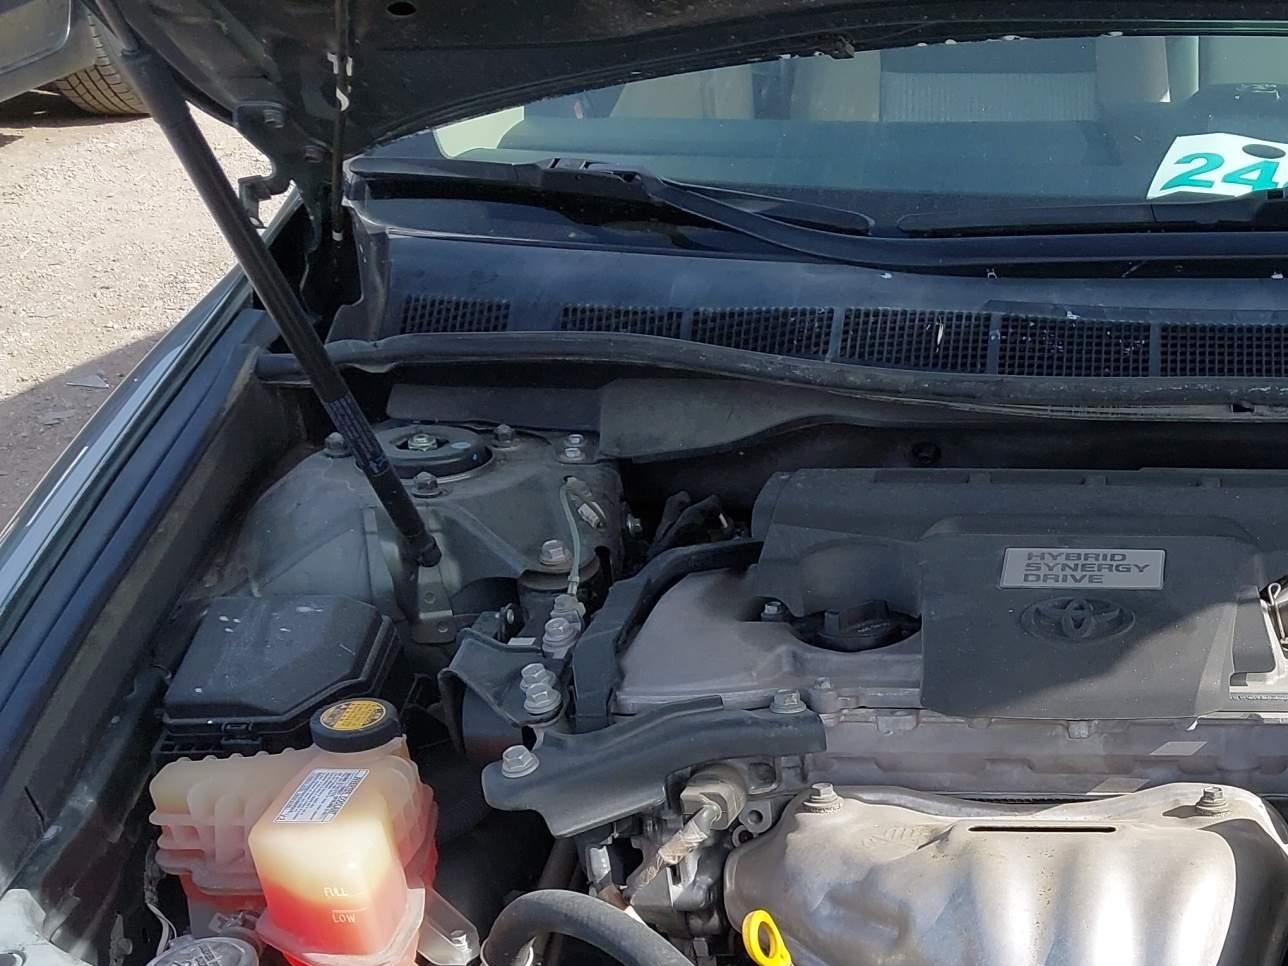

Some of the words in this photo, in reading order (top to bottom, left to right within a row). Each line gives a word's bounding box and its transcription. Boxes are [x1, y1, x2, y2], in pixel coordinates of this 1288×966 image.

[1027, 552, 1127, 562] HYBRID
[1024, 562, 1151, 573] SYNERGY
[1023, 573, 1104, 584] DRIVE
[323, 887, 349, 897] FULL
[332, 912, 356, 924] LOW
